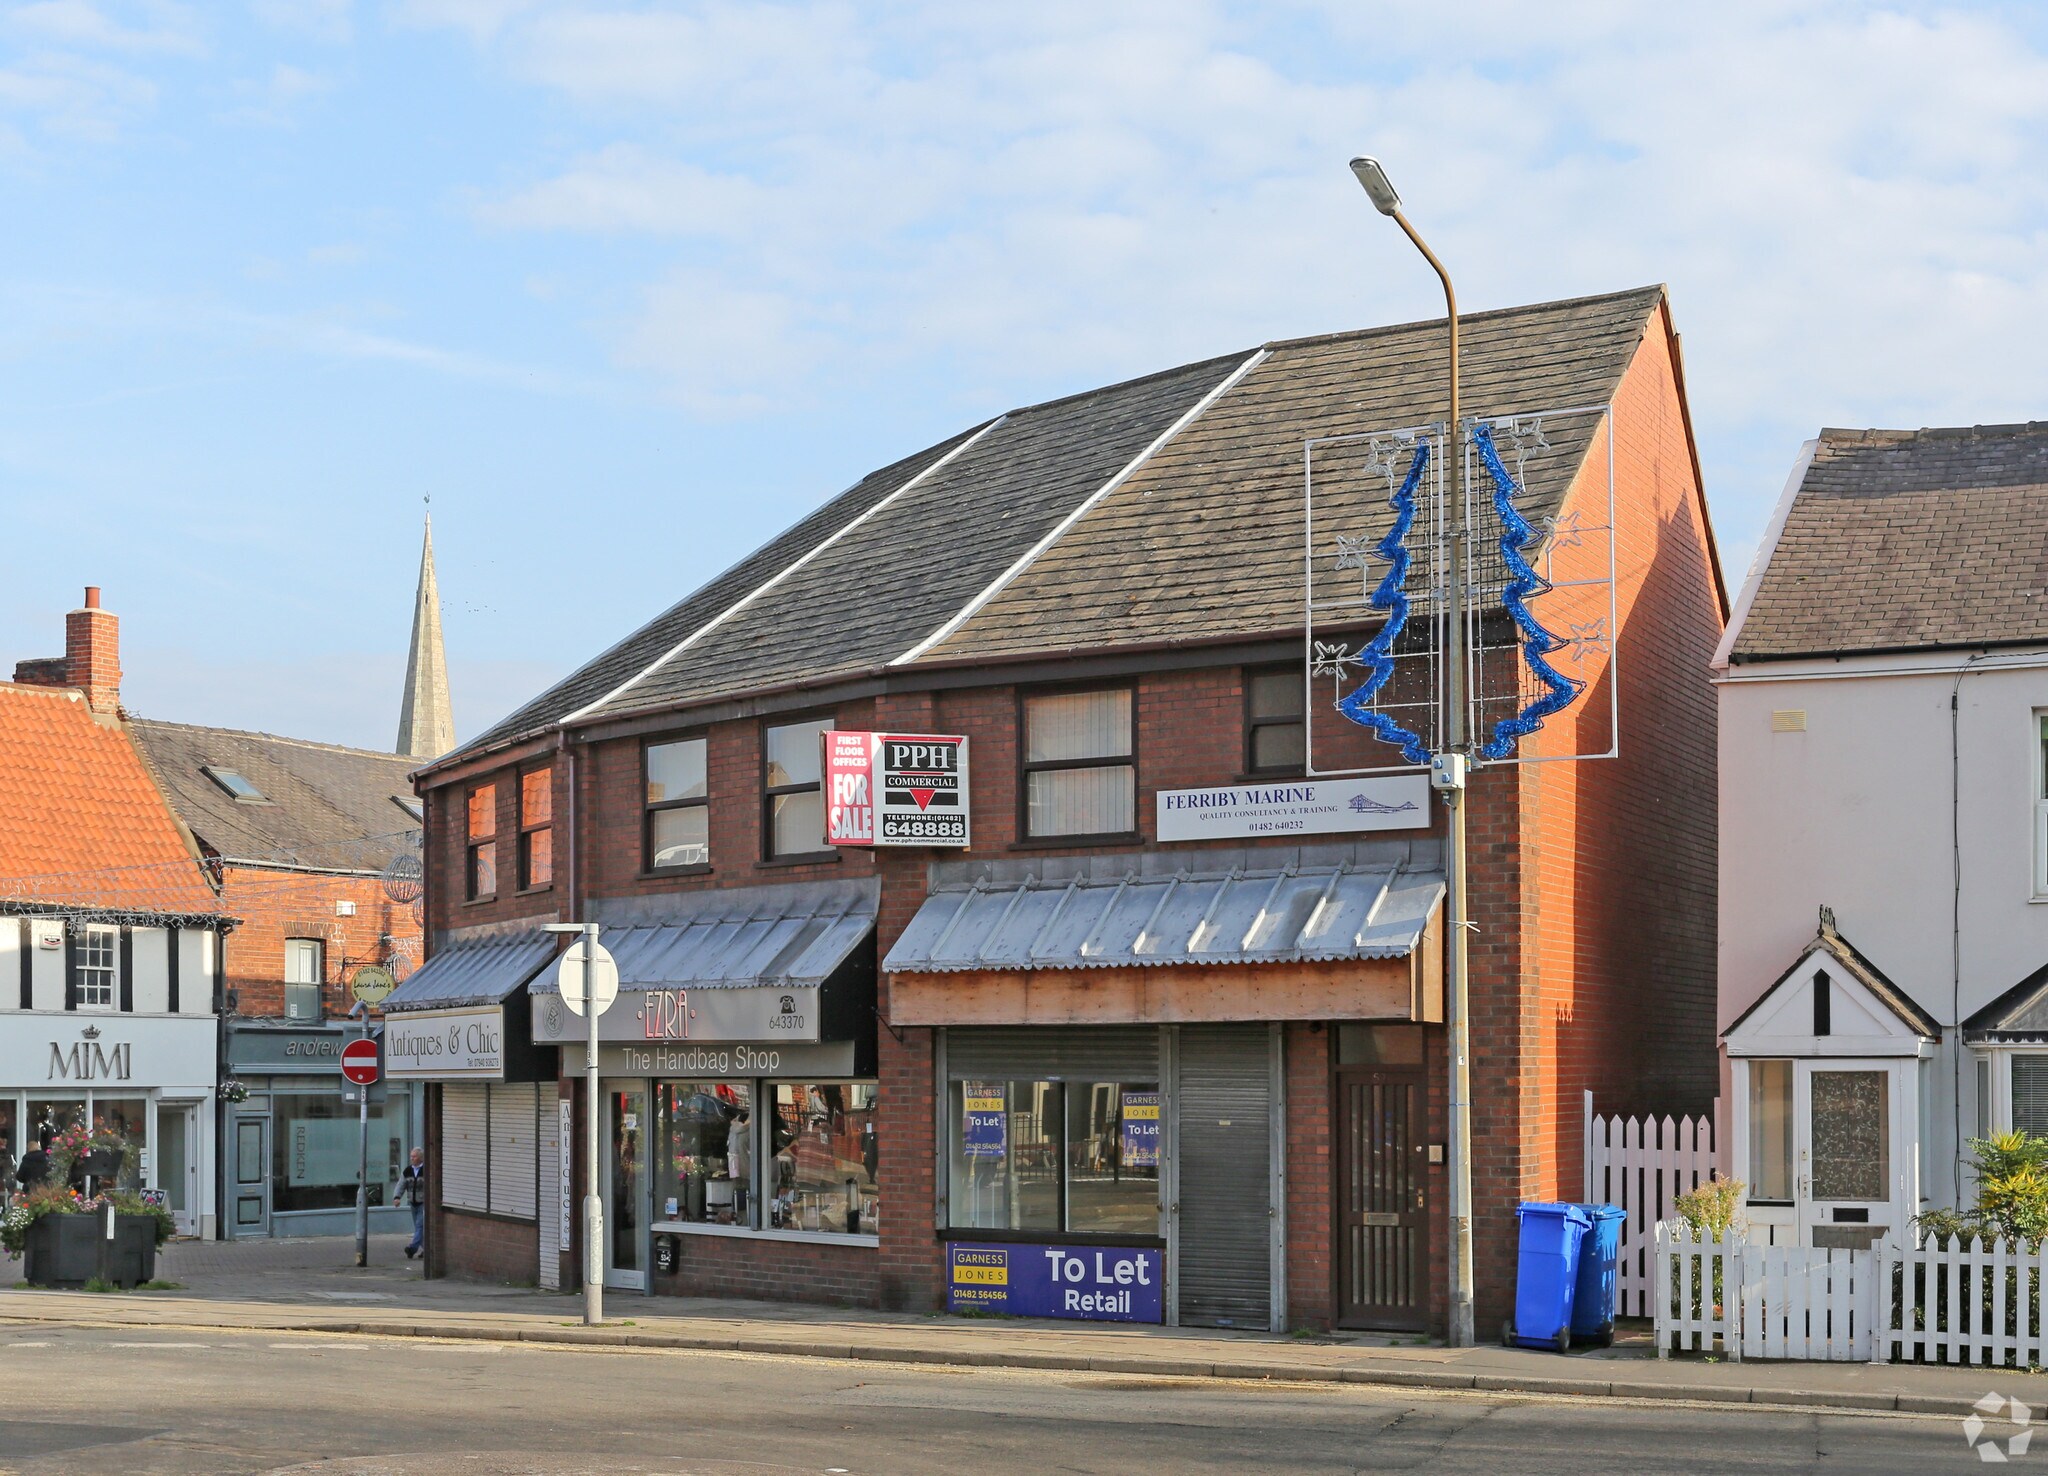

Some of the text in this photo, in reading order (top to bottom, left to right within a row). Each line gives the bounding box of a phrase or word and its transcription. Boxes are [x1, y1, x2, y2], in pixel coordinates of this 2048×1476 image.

[837, 736, 862, 745] FIRST
[835, 747, 864, 756] FLOOR
[891, 744, 950, 769] PPH
[833, 757, 867, 767] OFFICES
[833, 773, 868, 805] FOR
[888, 777, 955, 787] COMMERCIAL
[1166, 787, 1316, 810] FERRIBY MARINE
[1199, 811, 1234, 821] QUALITY
[1234, 808, 1288, 818] CONSULTANCY
[1299, 805, 1338, 815] TRAINING
[830, 806, 872, 839] SALE
[884, 822, 964, 836] 648888
[1249, 821, 1303, 832] 01482 640232
[644, 990, 688, 1038] EZRA
[769, 1015, 804, 1029] 643370
[286, 1037, 343, 1056] andrew
[388, 1022, 499, 1066] Antiques & Chic
[47, 1041, 132, 1080] MIMI
[622, 1045, 780, 1073] The Handbag Shop
[967, 1089, 1001, 1098] GARNESS
[968, 1101, 1000, 1109] JONES
[969, 1116, 999, 1126] To Let
[1128, 1125, 1160, 1135] To Let
[296, 1126, 305, 1179] REDKEN
[957, 1254, 1003, 1264] GARNESS
[957, 1270, 1003, 1280] JONES
[1045, 1250, 1150, 1286] To Let
[953, 1289, 1007, 1300] 01482 564564
[1065, 1289, 1130, 1313] Retail
